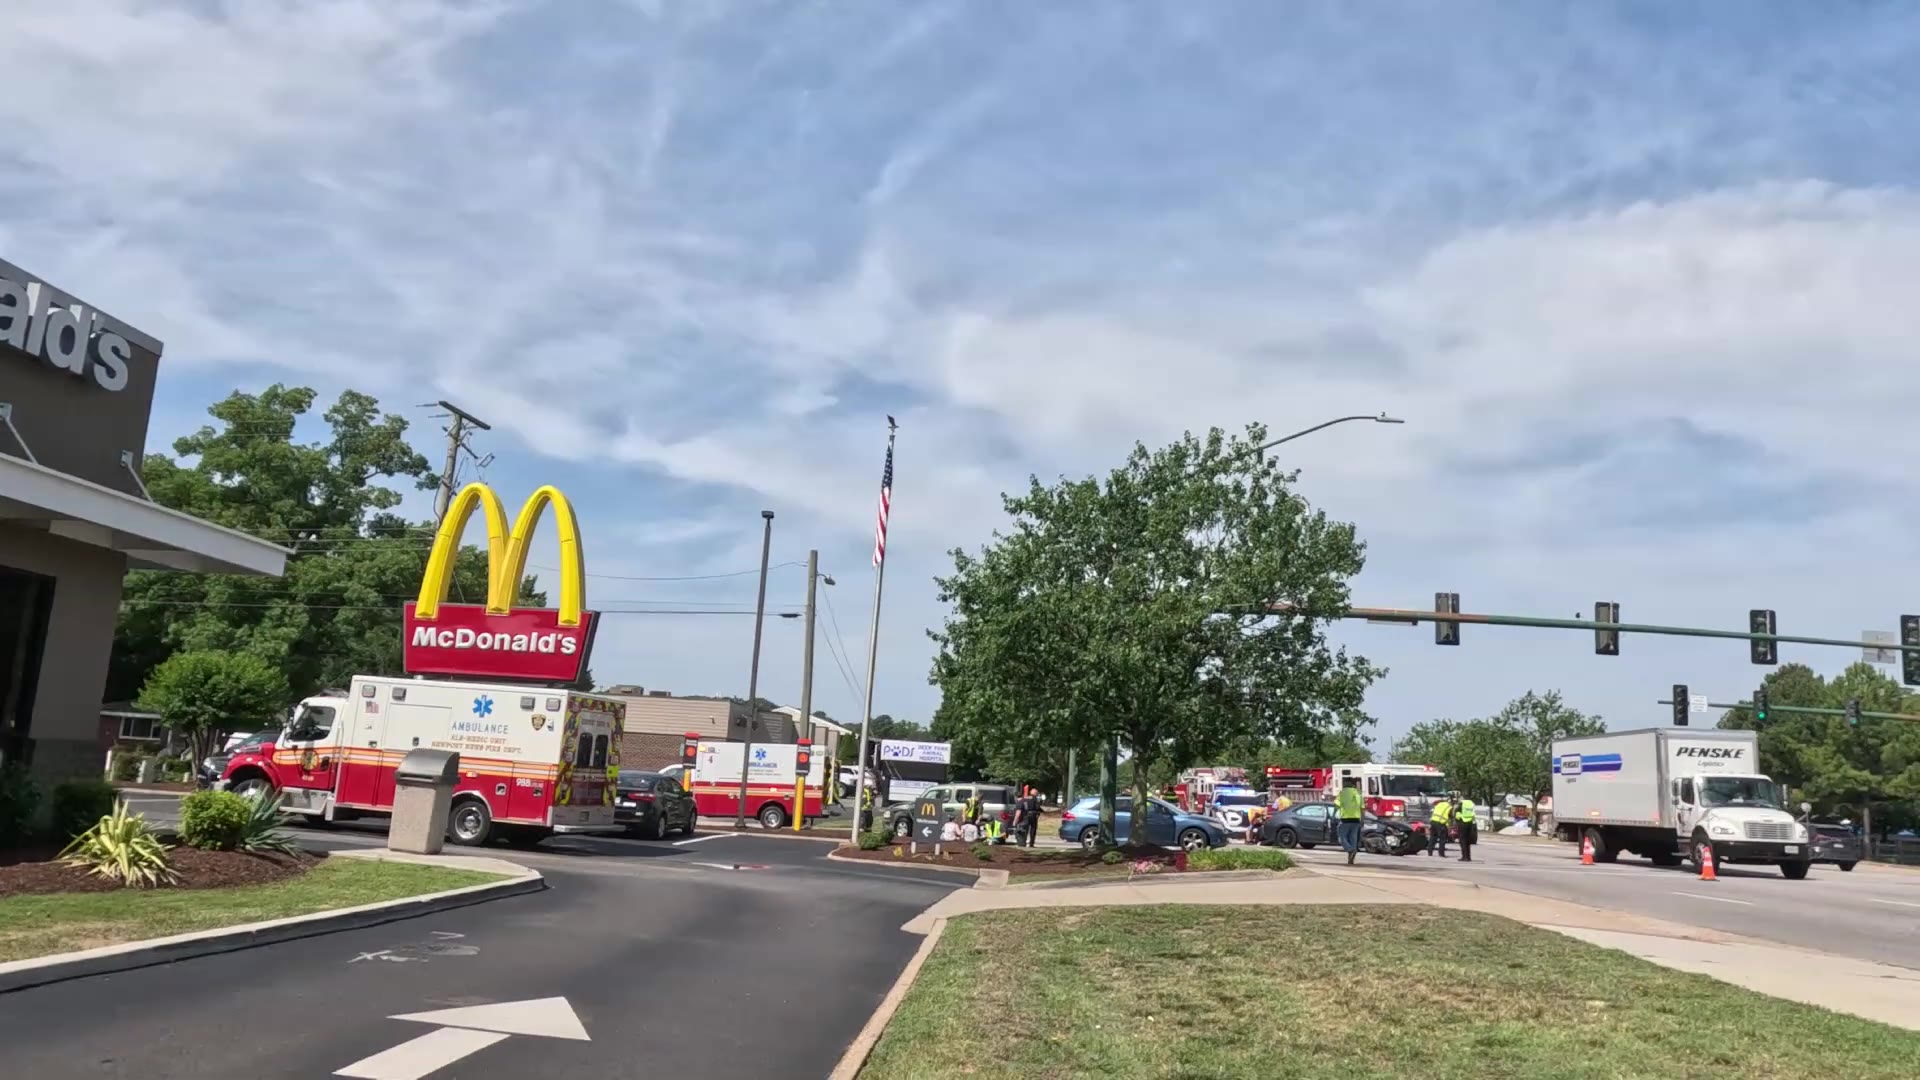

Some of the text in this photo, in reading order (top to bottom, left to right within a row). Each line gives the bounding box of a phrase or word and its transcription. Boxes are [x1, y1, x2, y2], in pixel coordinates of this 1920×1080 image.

[412, 625, 577, 655] McDonald's
[451, 721, 509, 735] AMBULANCE
[1675, 746, 1745, 759] PENSKE
